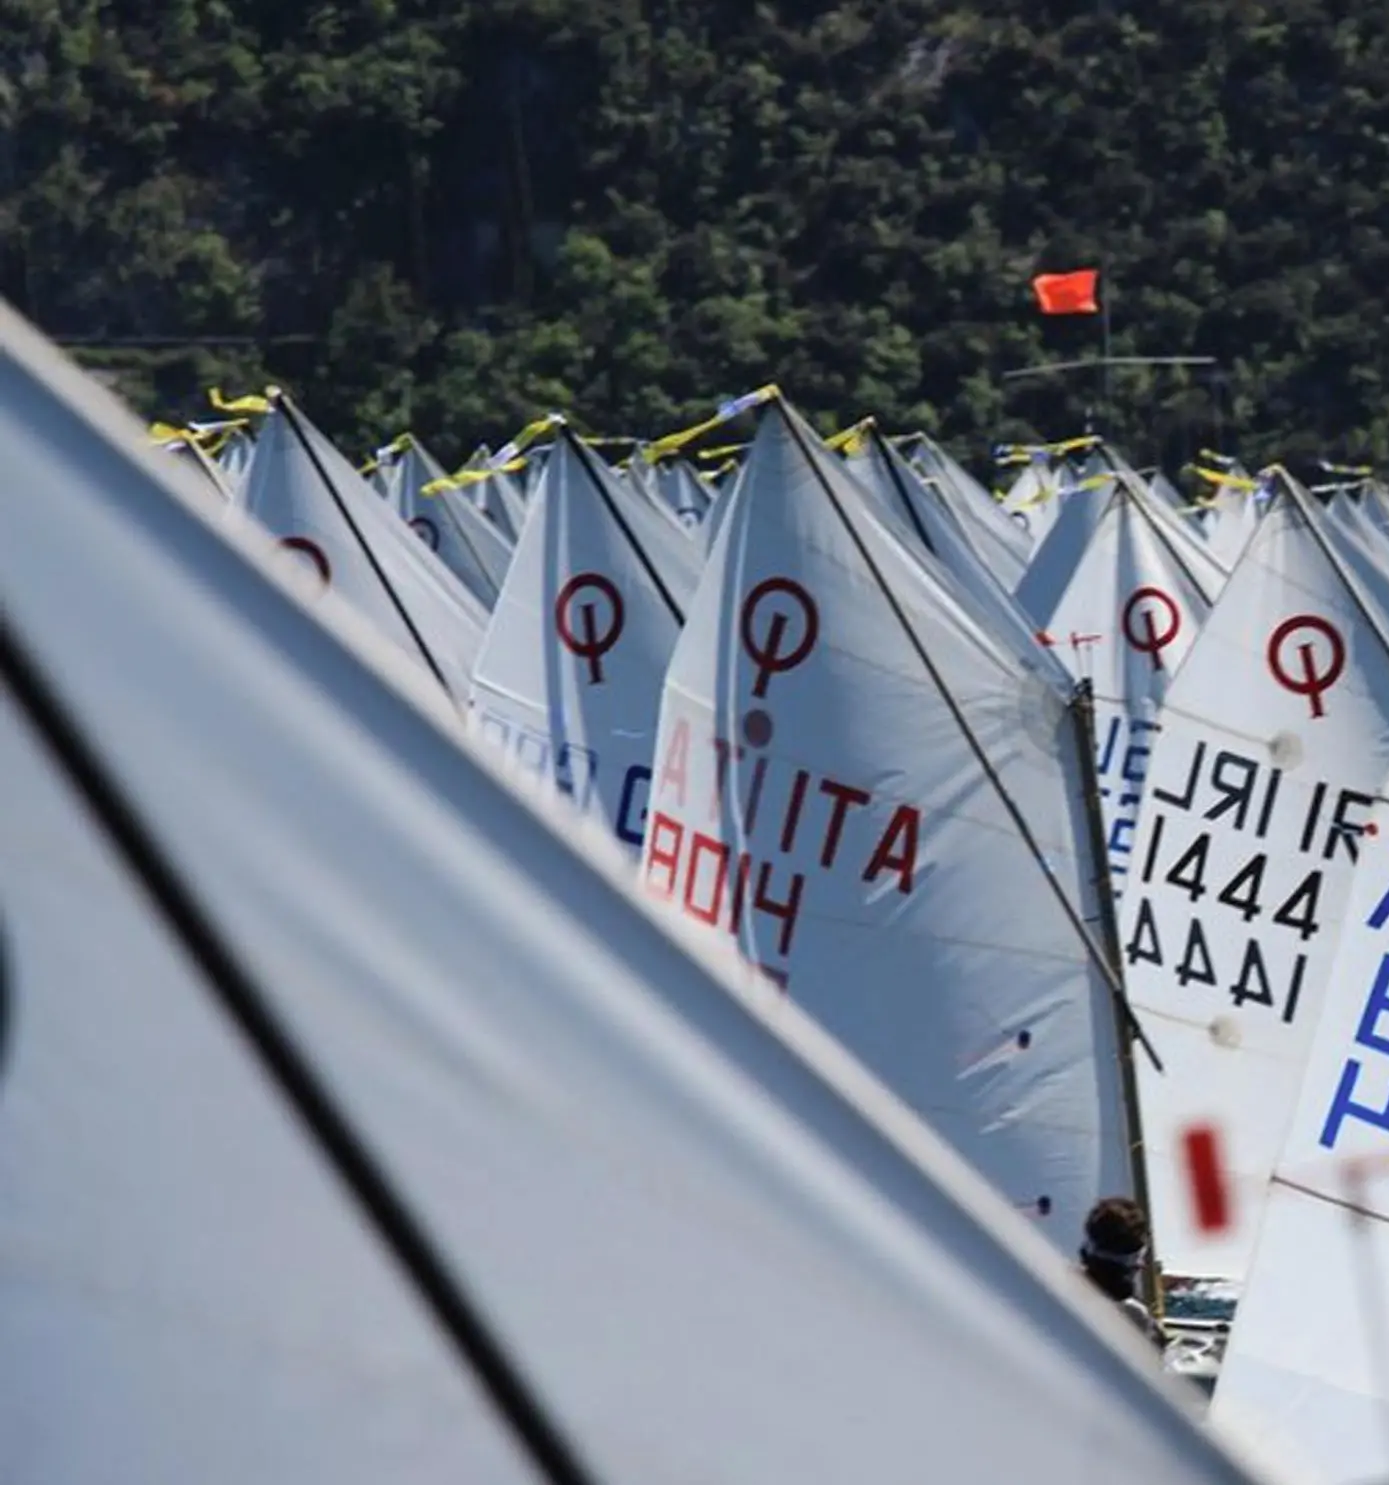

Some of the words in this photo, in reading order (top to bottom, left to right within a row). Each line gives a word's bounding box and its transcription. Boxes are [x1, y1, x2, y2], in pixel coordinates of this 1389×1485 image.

[646, 810, 806, 956] 8014
[779, 768, 921, 895] ITA
[1142, 813, 1320, 941] 1444
